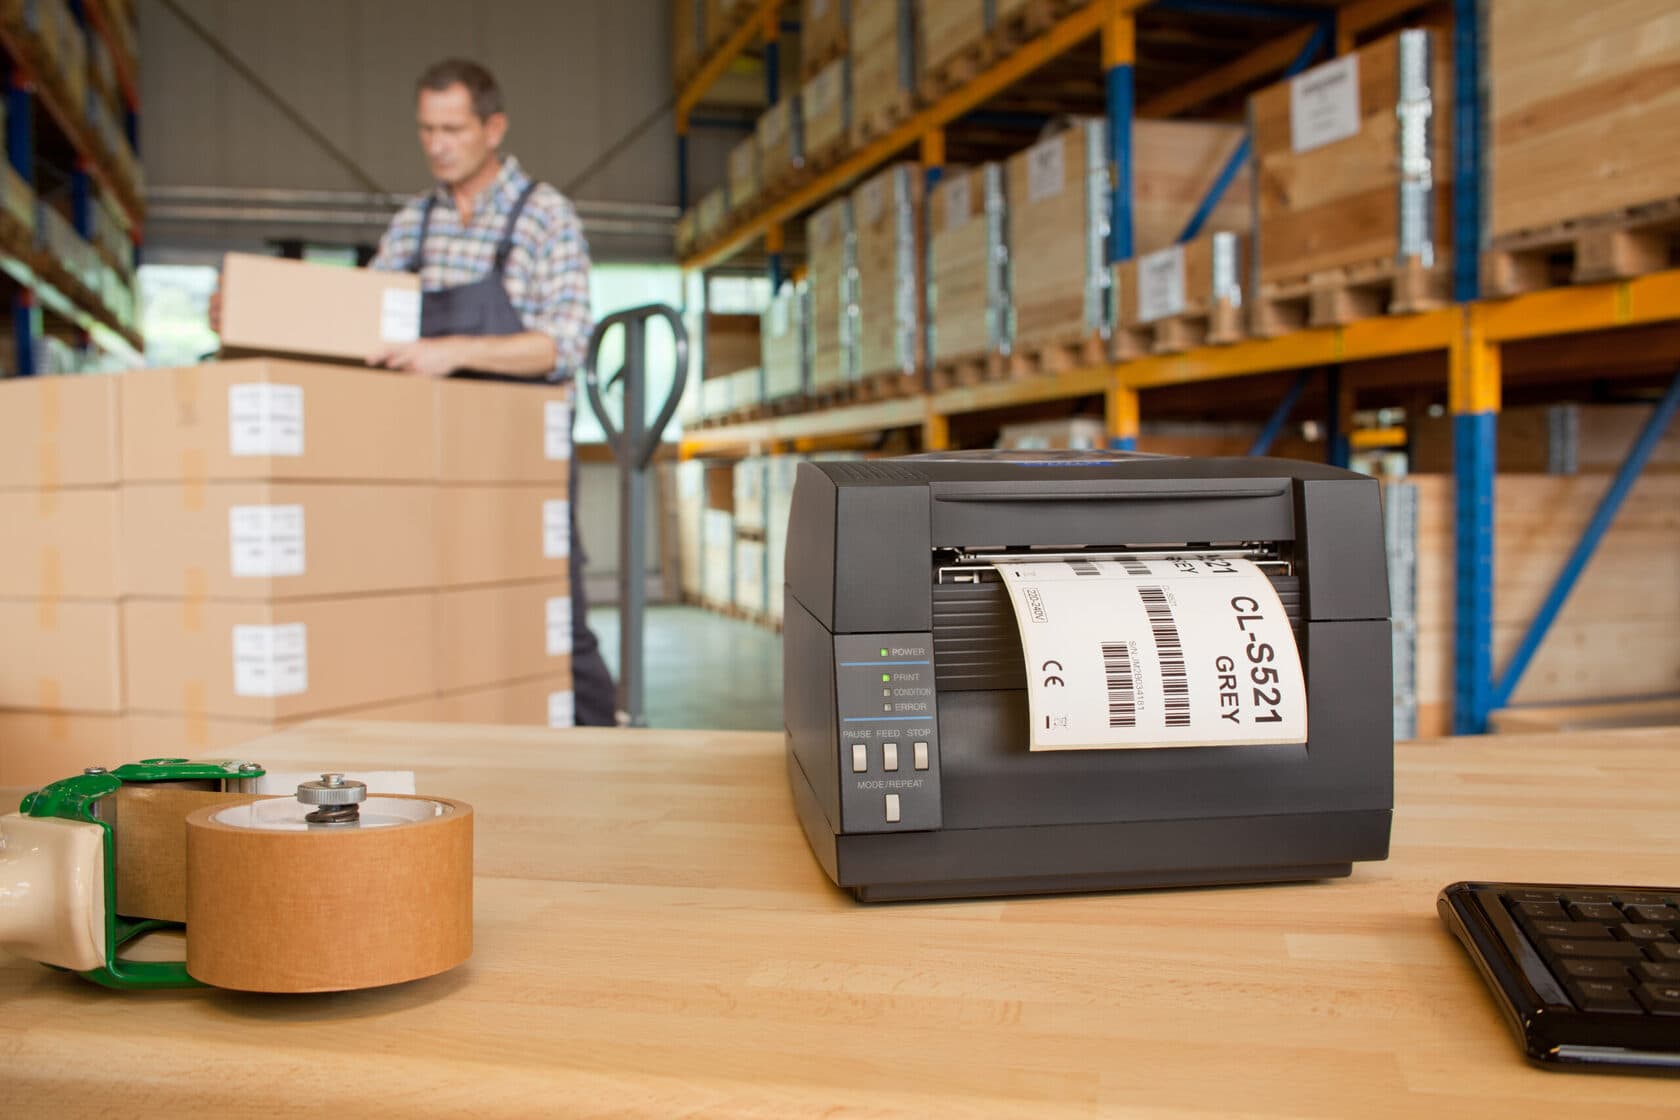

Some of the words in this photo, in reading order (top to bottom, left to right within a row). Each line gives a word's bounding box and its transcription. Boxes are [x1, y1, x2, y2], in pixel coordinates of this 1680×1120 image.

[891, 648, 925, 657] POWER
[1231, 596, 1283, 723] CL-S521
[893, 673, 921, 681] PRINT
[894, 688, 932, 697] CONDITION
[1215, 656, 1240, 724] GREY
[895, 703, 927, 712] ERROR
[842, 730, 872, 738] PAUSE
[876, 729, 900, 738] FEED
[906, 728, 931, 737] STOP
[857, 780, 924, 789] MODE/REPEAT
